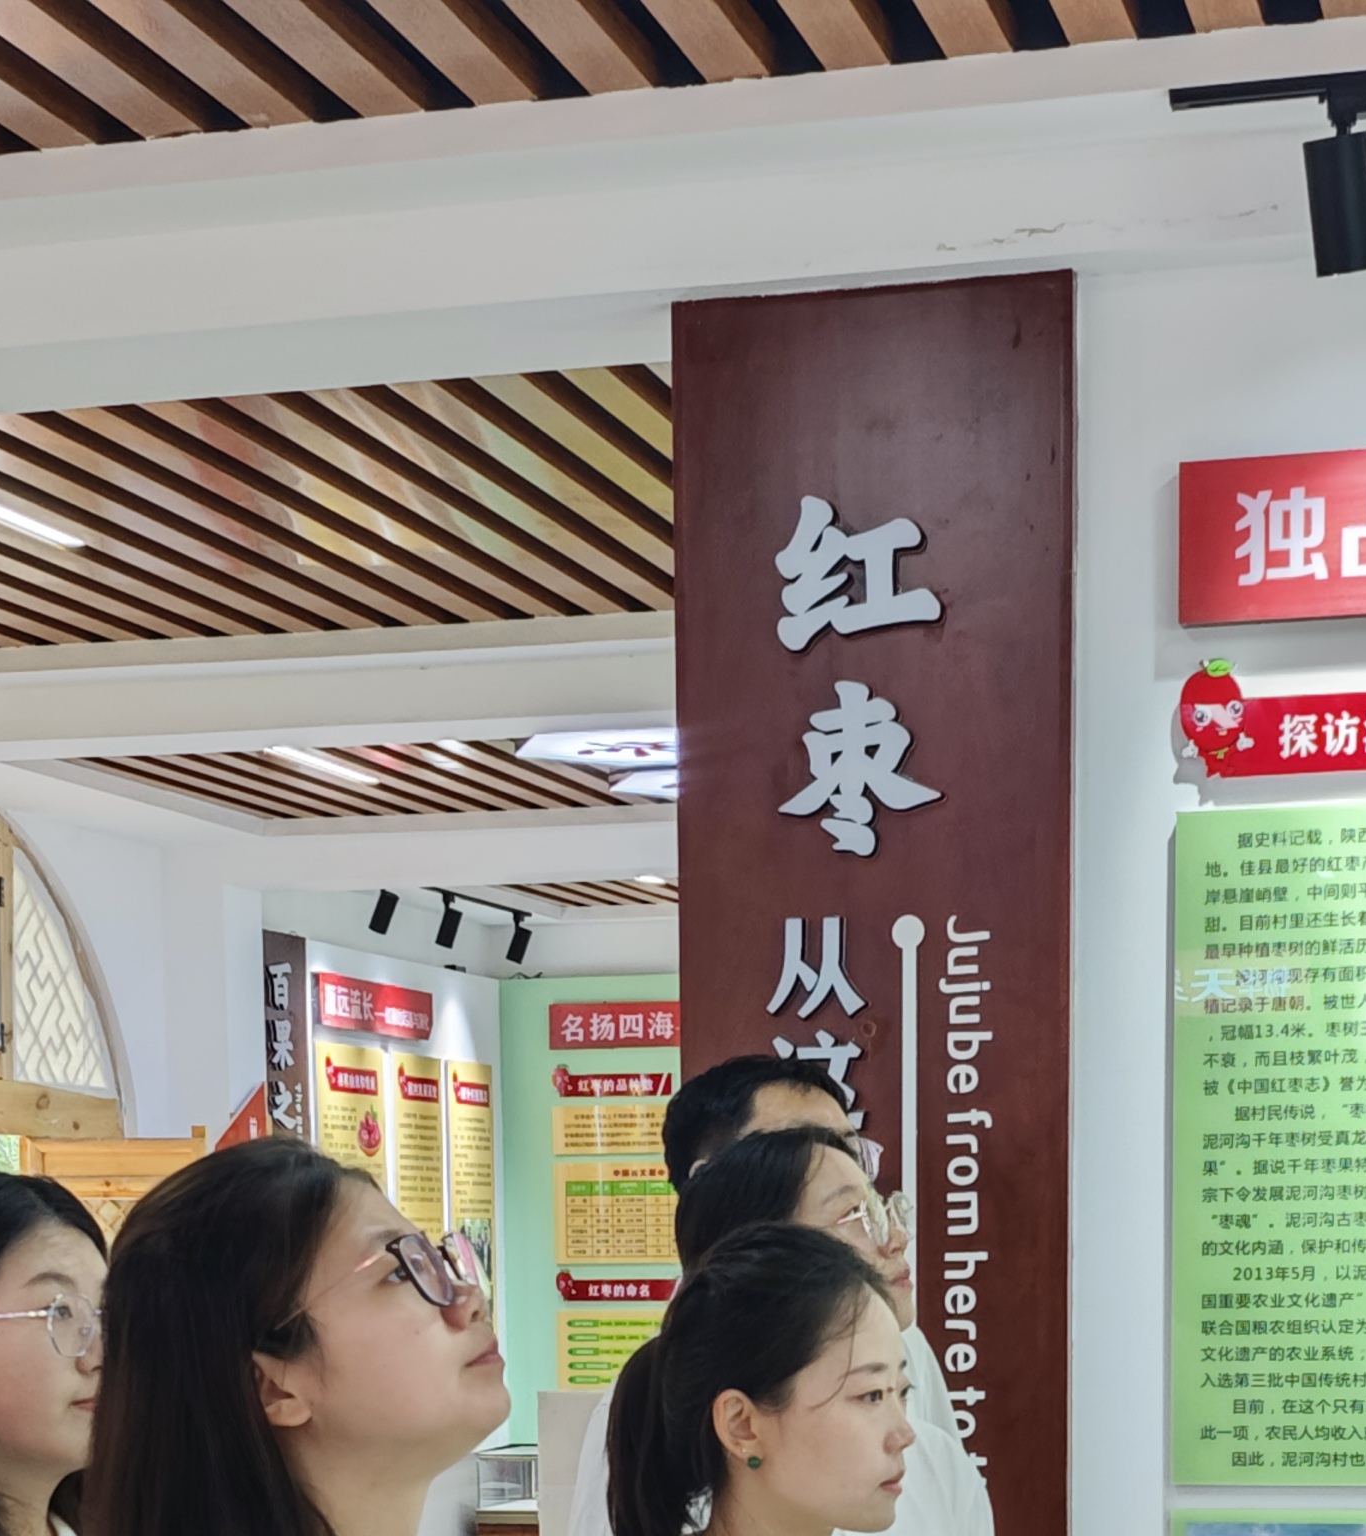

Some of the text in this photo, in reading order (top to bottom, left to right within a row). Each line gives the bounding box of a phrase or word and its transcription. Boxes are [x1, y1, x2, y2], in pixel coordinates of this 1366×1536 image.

[560, 1010, 674, 1043] 名扬四海
[938, 915, 993, 1094] Jujube
[945, 1108, 993, 1235] from
[587, 1283, 651, 1298] 红枣的命名
[944, 1251, 989, 1373] here
[948, 1386, 986, 1439] to
